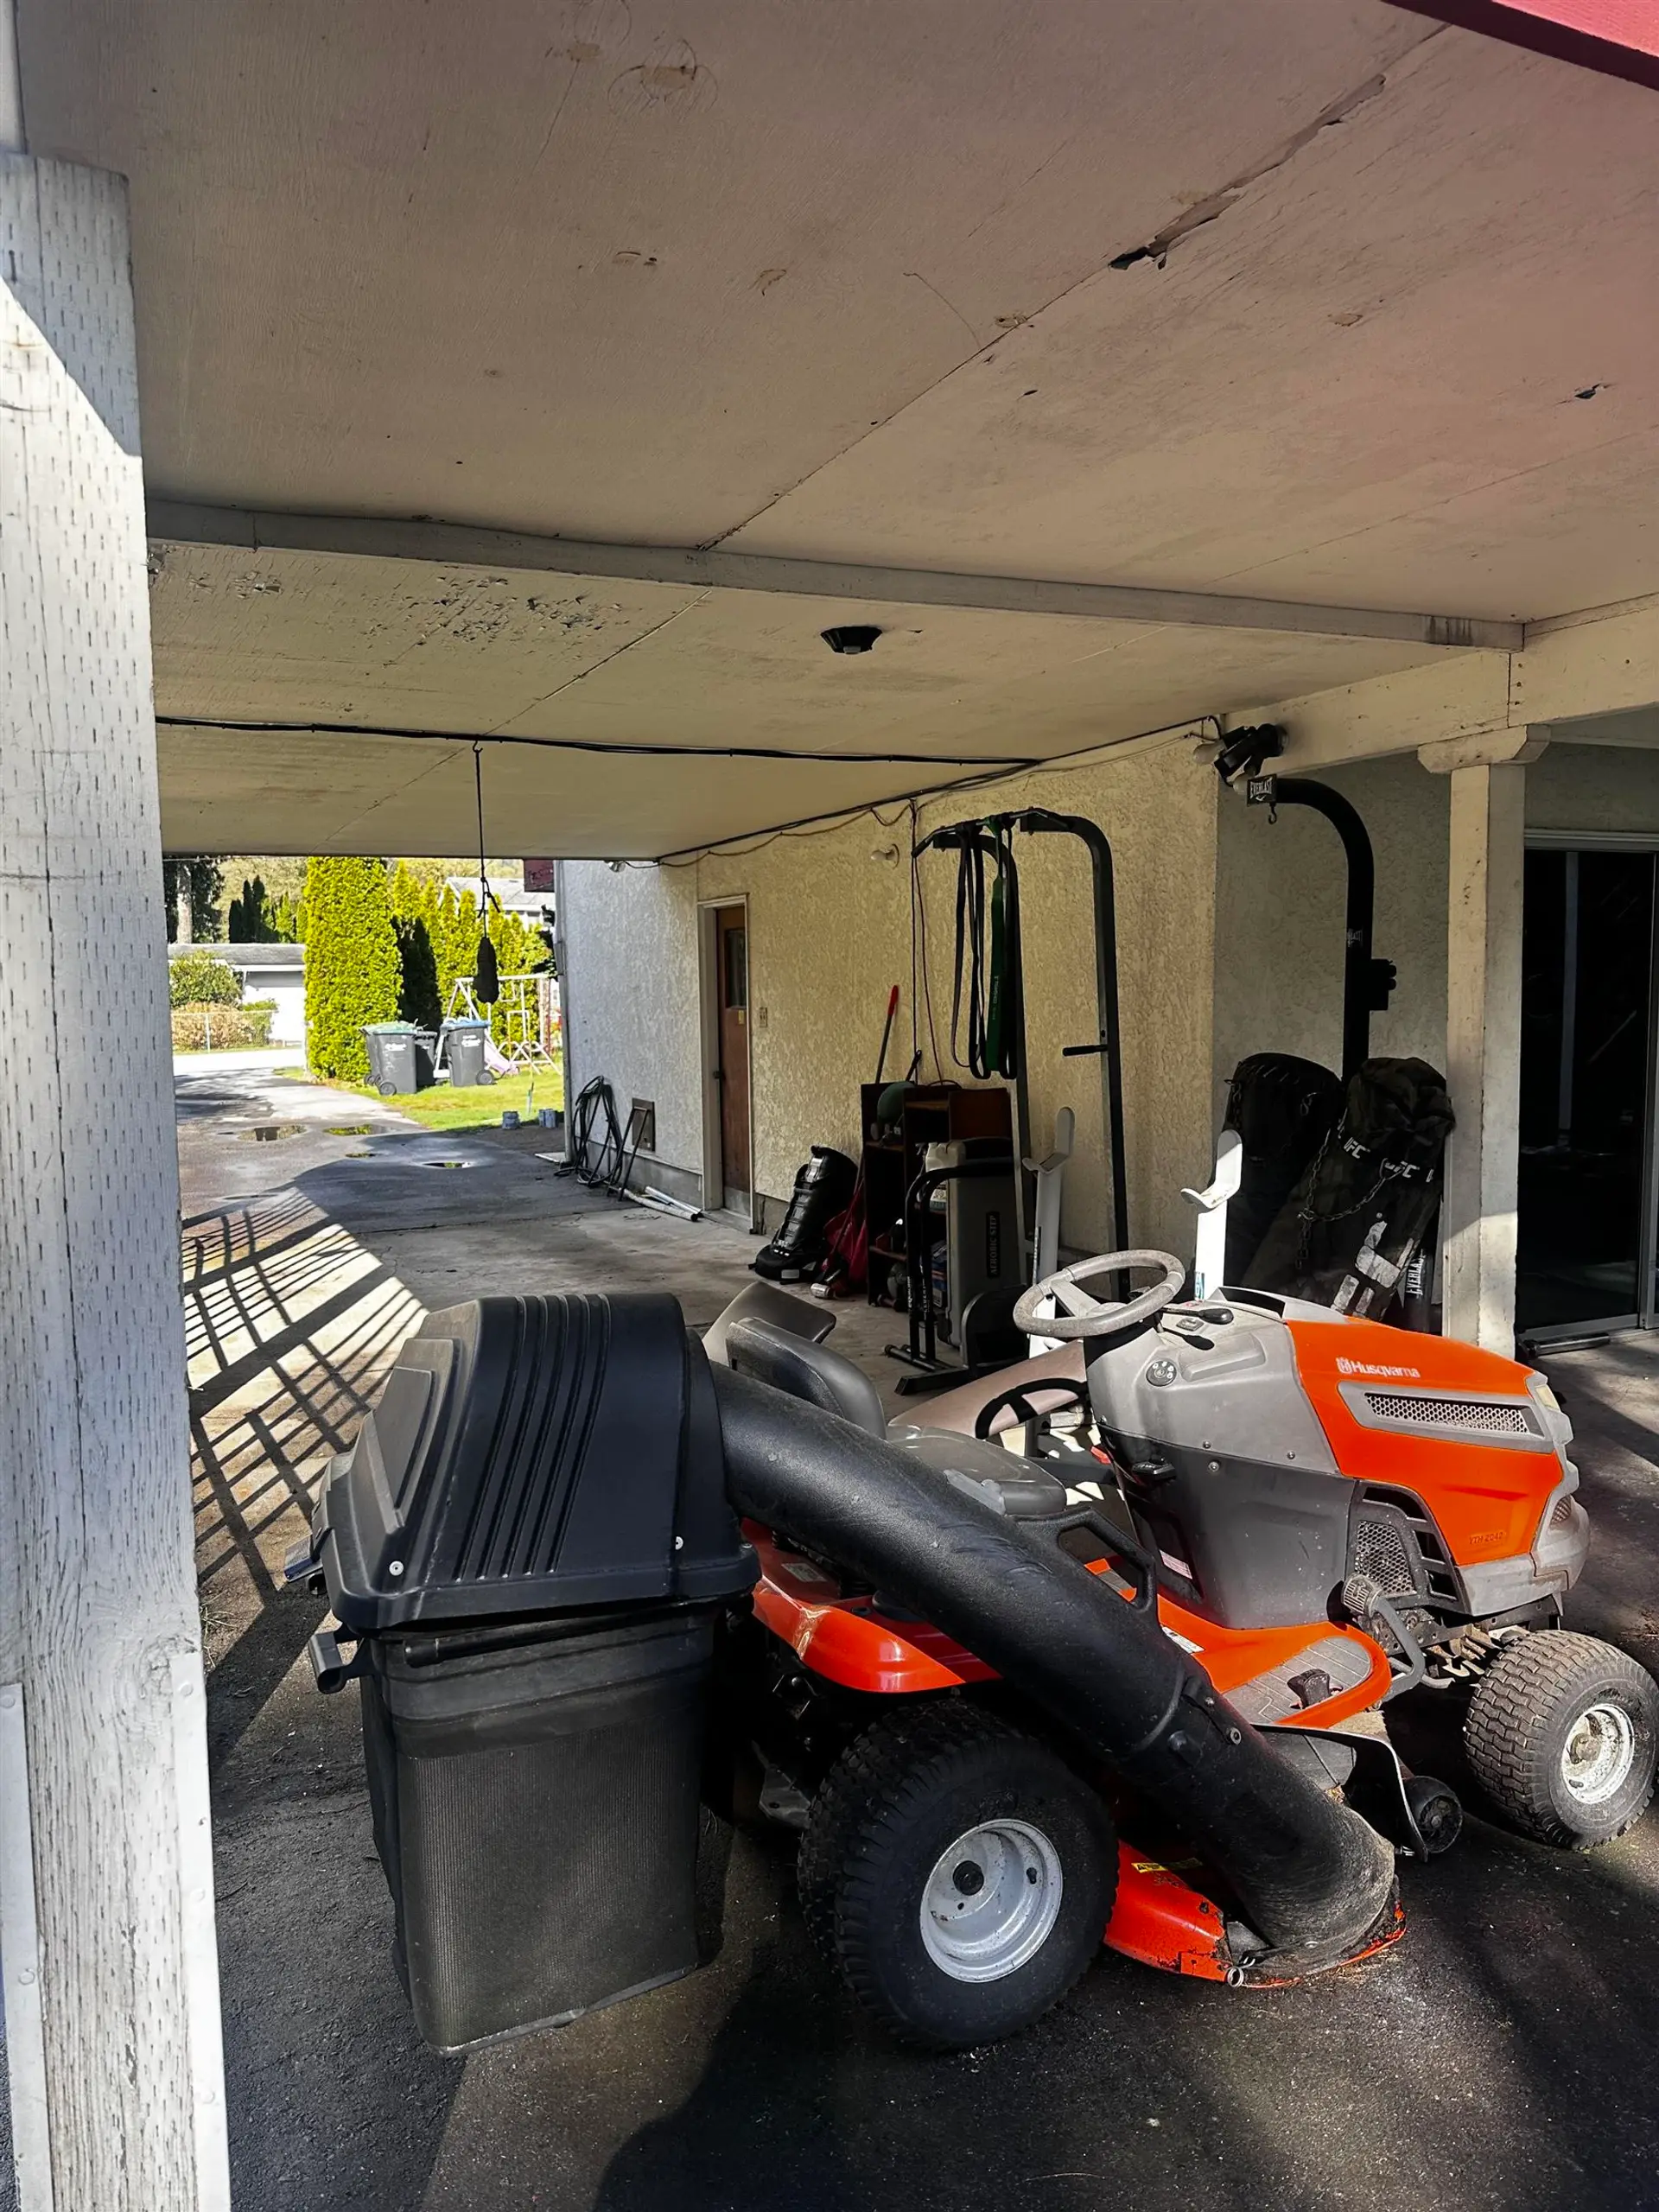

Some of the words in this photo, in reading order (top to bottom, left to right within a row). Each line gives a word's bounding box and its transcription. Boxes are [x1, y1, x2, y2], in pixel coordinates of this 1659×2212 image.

[1249, 777, 1273, 799] EVERLAST
[1344, 1137, 1368, 1159] UFC
[1351, 1360, 1421, 1378] Husqvarna
